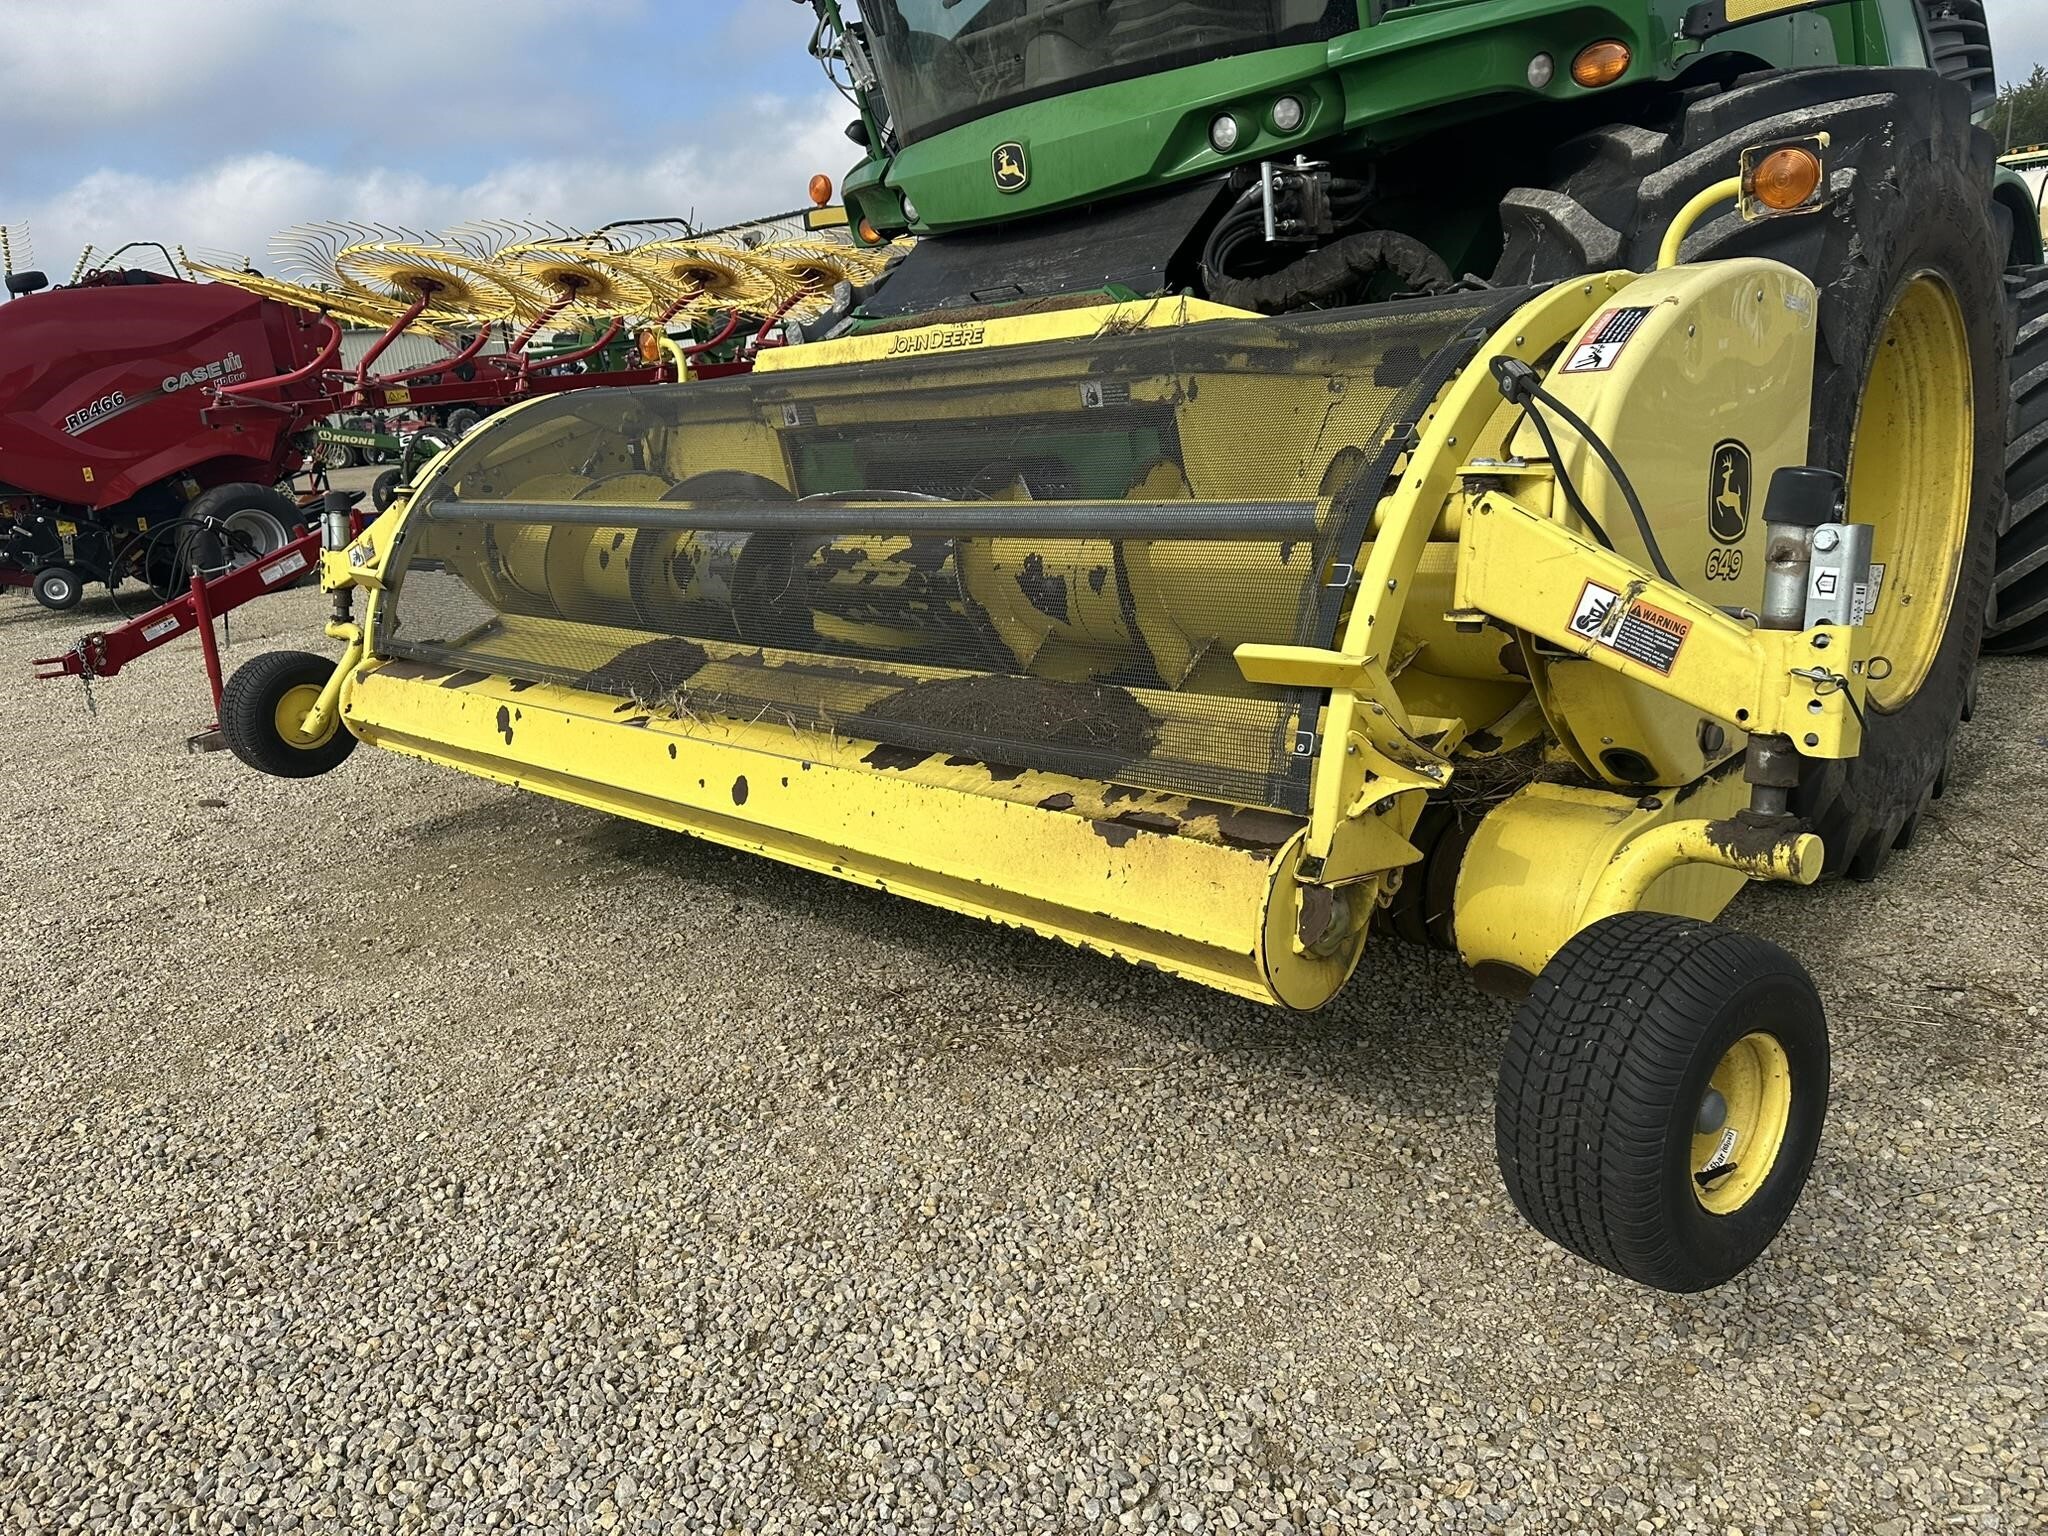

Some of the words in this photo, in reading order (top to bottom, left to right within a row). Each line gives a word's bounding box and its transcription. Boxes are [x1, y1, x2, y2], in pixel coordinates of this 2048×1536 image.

[888, 334, 930, 355] JOHN
[930, 328, 985, 349] DEERE
[162, 361, 223, 393] CASE
[223, 351, 243, 373] IH
[67, 391, 125, 429] RB466
[332, 434, 376, 446] KRONE
[1705, 548, 1744, 581] 649
[1643, 609, 1687, 635] WARNING
